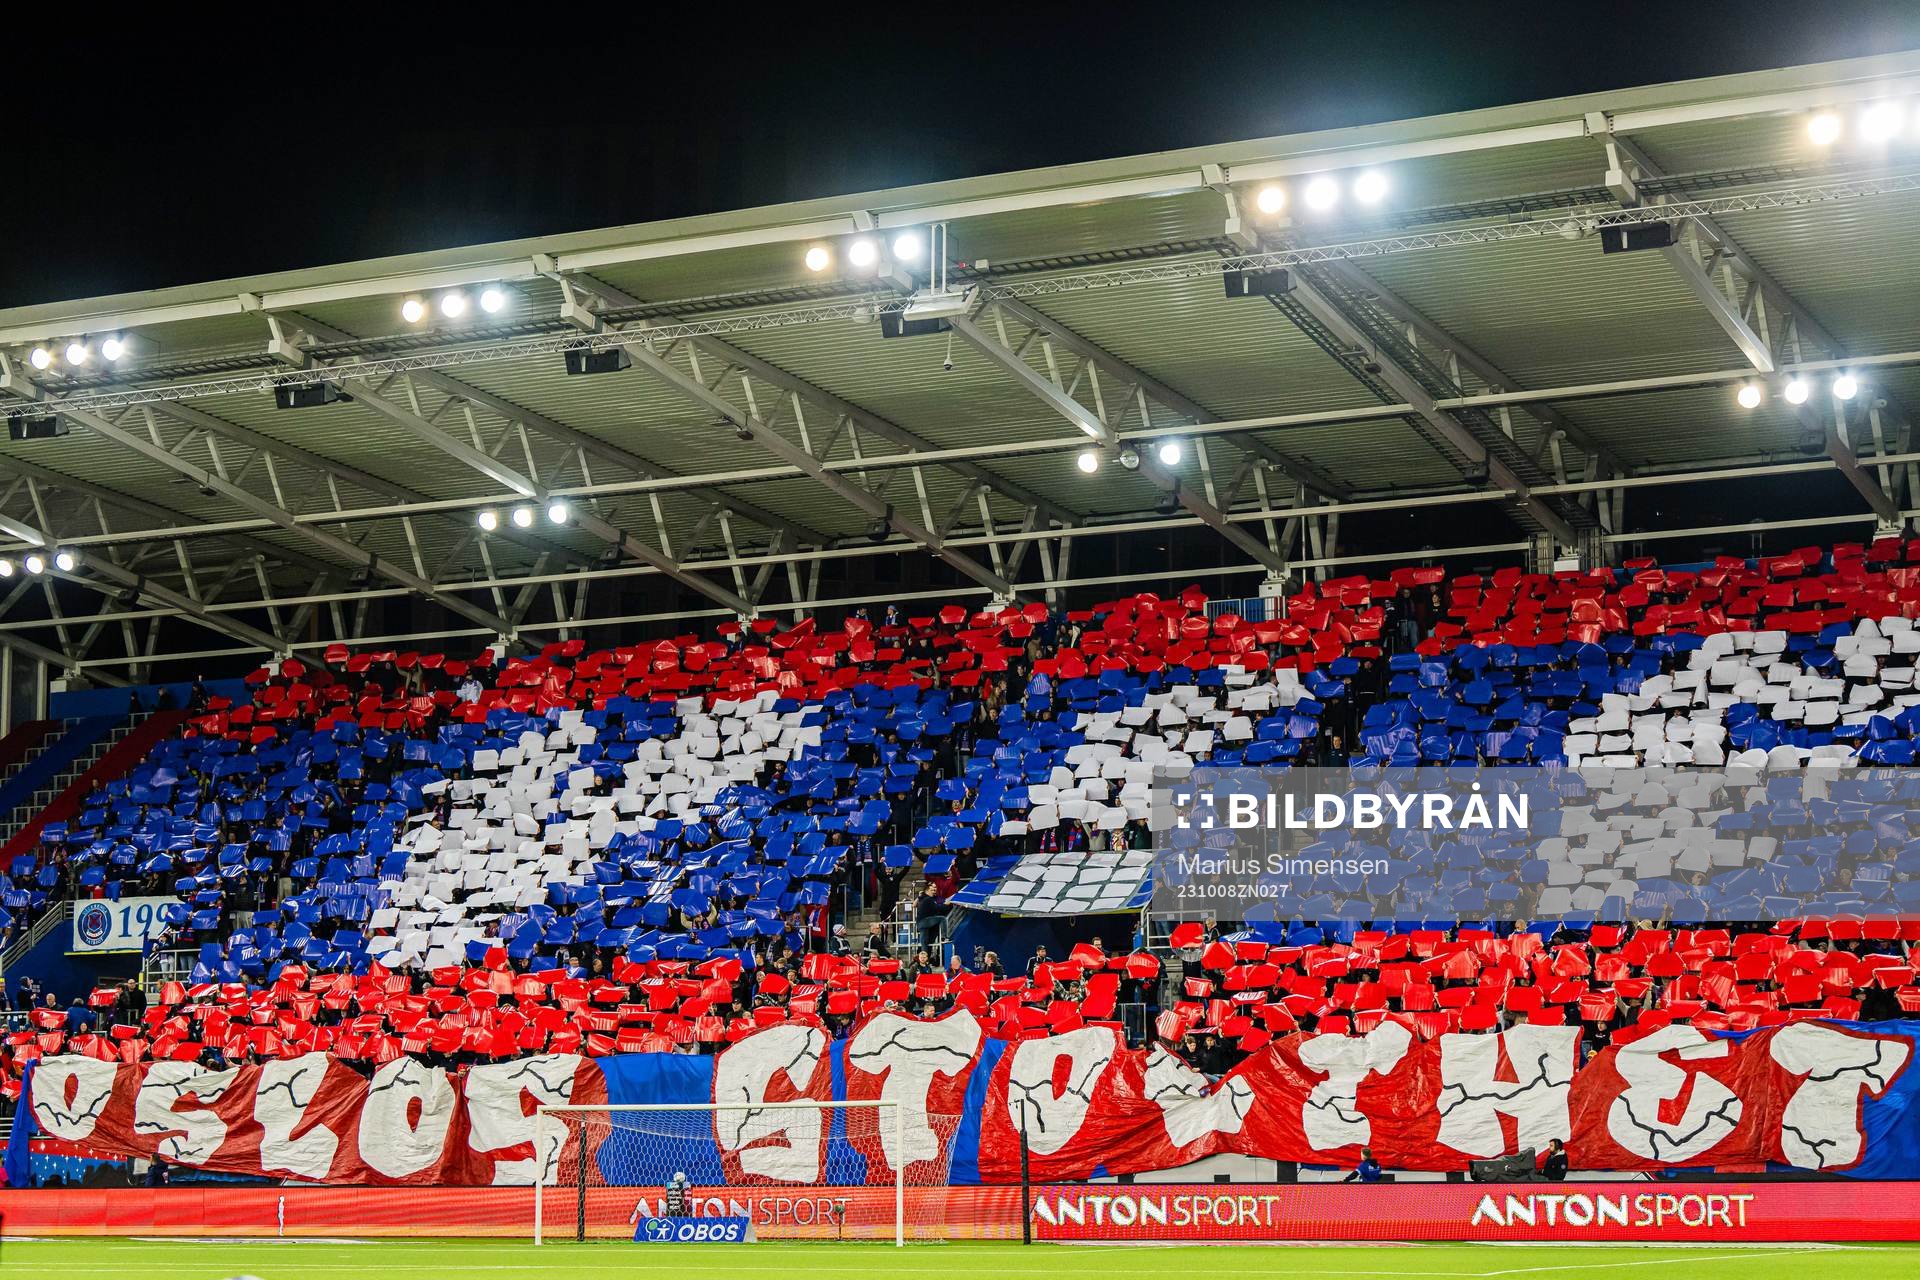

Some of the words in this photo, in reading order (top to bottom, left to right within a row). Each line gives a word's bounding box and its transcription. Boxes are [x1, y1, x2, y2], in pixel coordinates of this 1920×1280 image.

[760, 1197, 853, 1226] SPORT
[1030, 1195, 1167, 1226] ANTON
[1173, 1195, 1280, 1227] SPORT
[1471, 1194, 1629, 1226] ANTON
[1634, 1194, 1754, 1227] SPORT
[677, 1223, 740, 1241] OBOS
